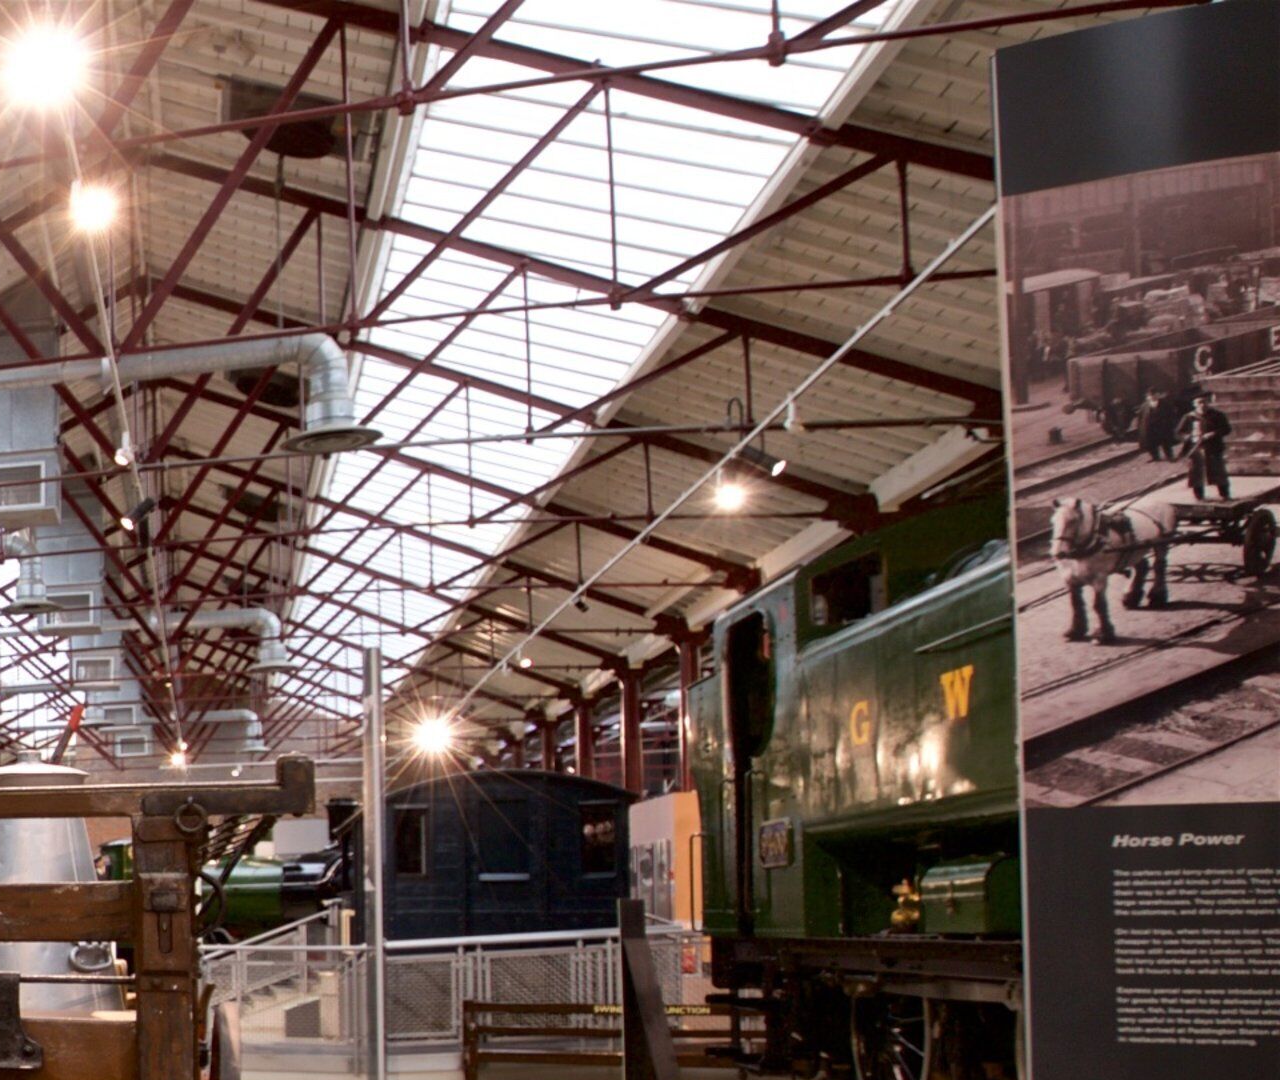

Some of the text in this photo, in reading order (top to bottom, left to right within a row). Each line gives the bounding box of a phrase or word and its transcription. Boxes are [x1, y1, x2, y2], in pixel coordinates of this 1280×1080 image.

[850, 664, 974, 745] G W
[1111, 831, 1246, 848] Horse Power
